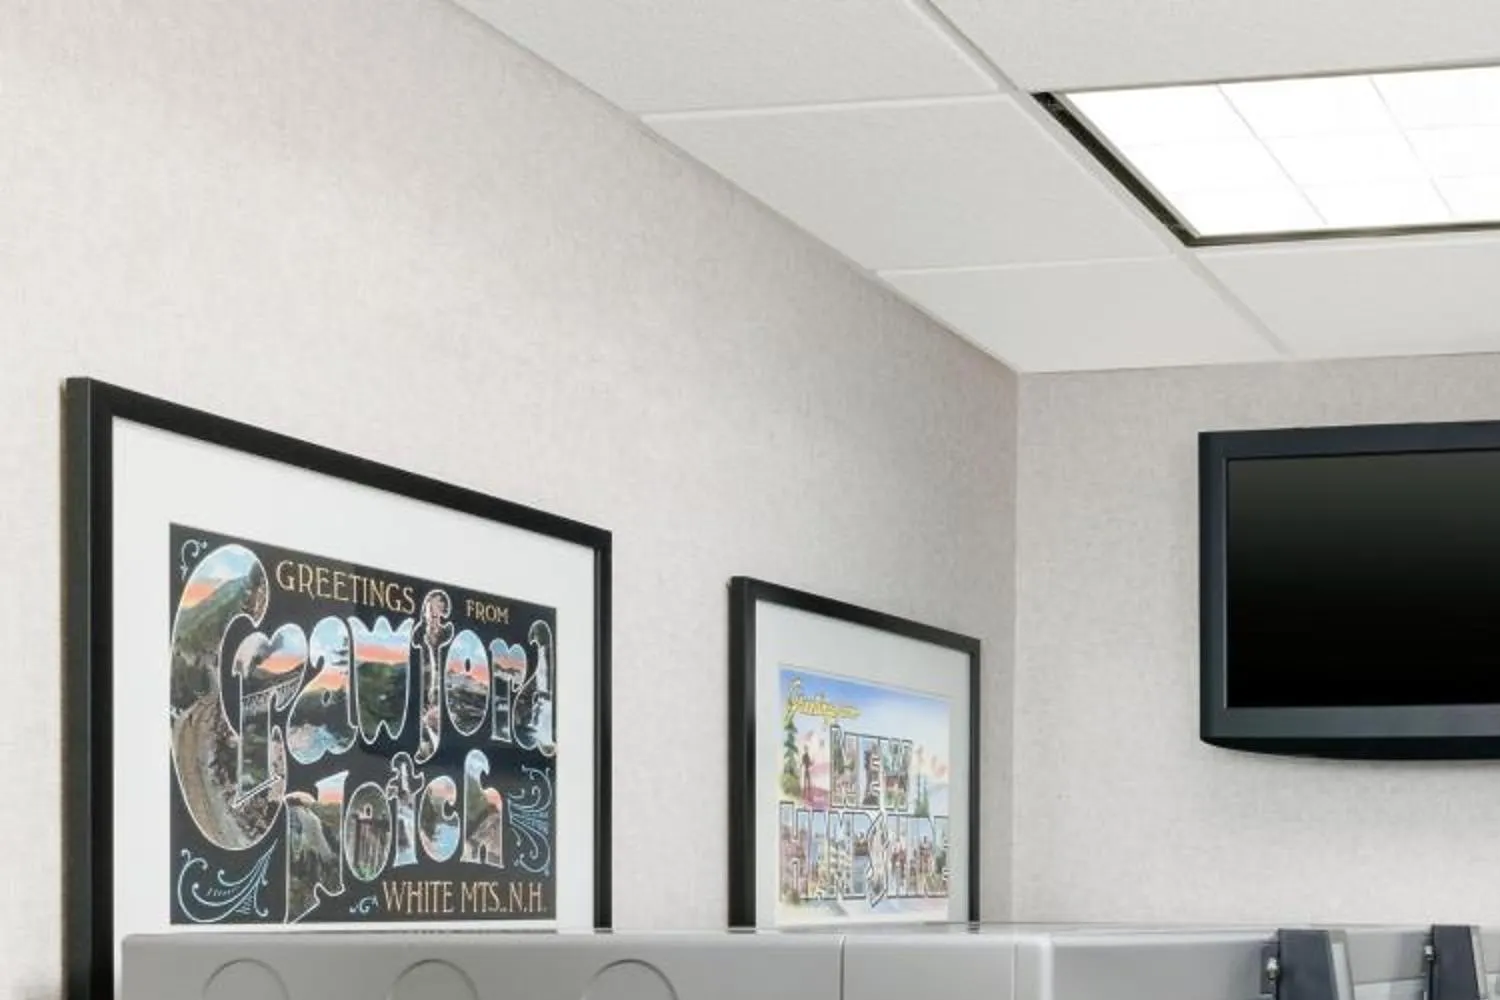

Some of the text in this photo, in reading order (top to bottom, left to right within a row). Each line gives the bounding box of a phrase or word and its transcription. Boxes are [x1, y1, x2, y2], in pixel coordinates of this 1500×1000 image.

[275, 559, 510, 625] GREETINGS FROM
[382, 880, 455, 913] WHITE
